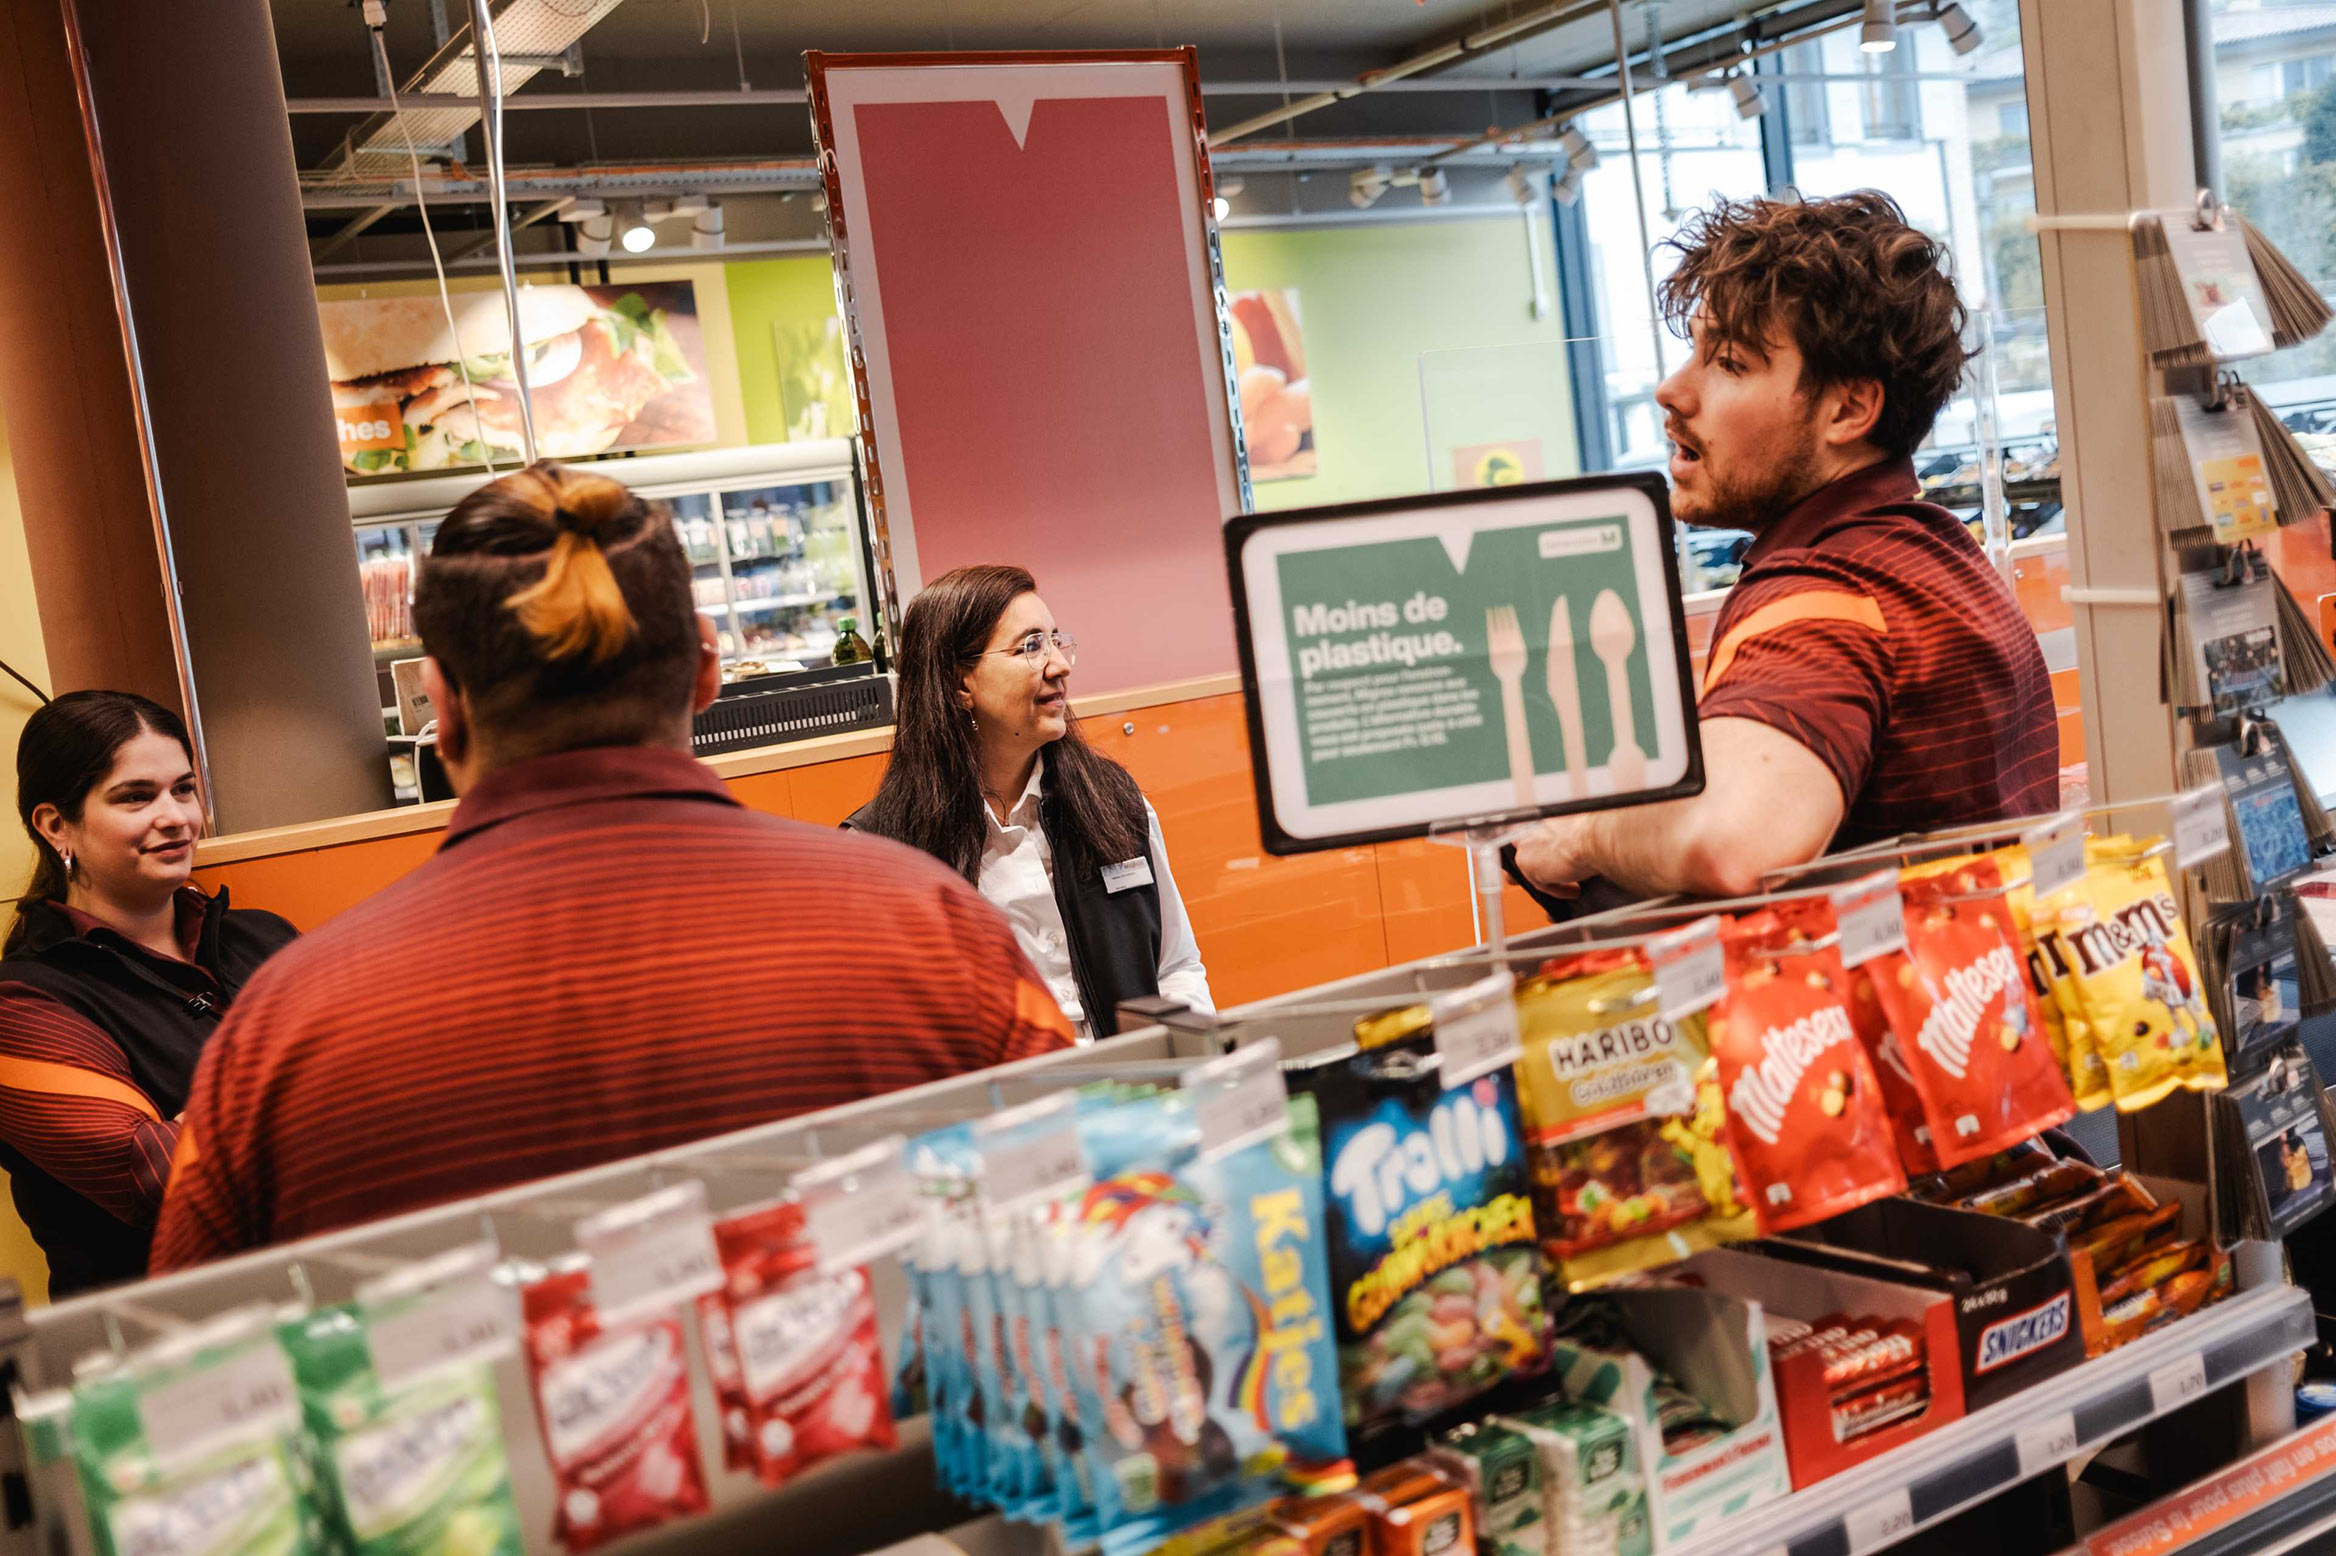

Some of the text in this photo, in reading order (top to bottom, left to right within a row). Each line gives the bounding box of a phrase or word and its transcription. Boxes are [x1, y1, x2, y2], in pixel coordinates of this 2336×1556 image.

[1293, 590, 1448, 637] Moins de
[1299, 630, 1464, 680] plastique.
[1555, 1017, 1673, 1074] HARIBO
[1331, 1092, 1508, 1237] Trolli
[1250, 1188, 1323, 1430] Katjes
[1983, 1299, 2066, 1365] SNICKERS
[2191, 1486, 2229, 1519] pour
[2228, 1468, 2265, 1496] plus
